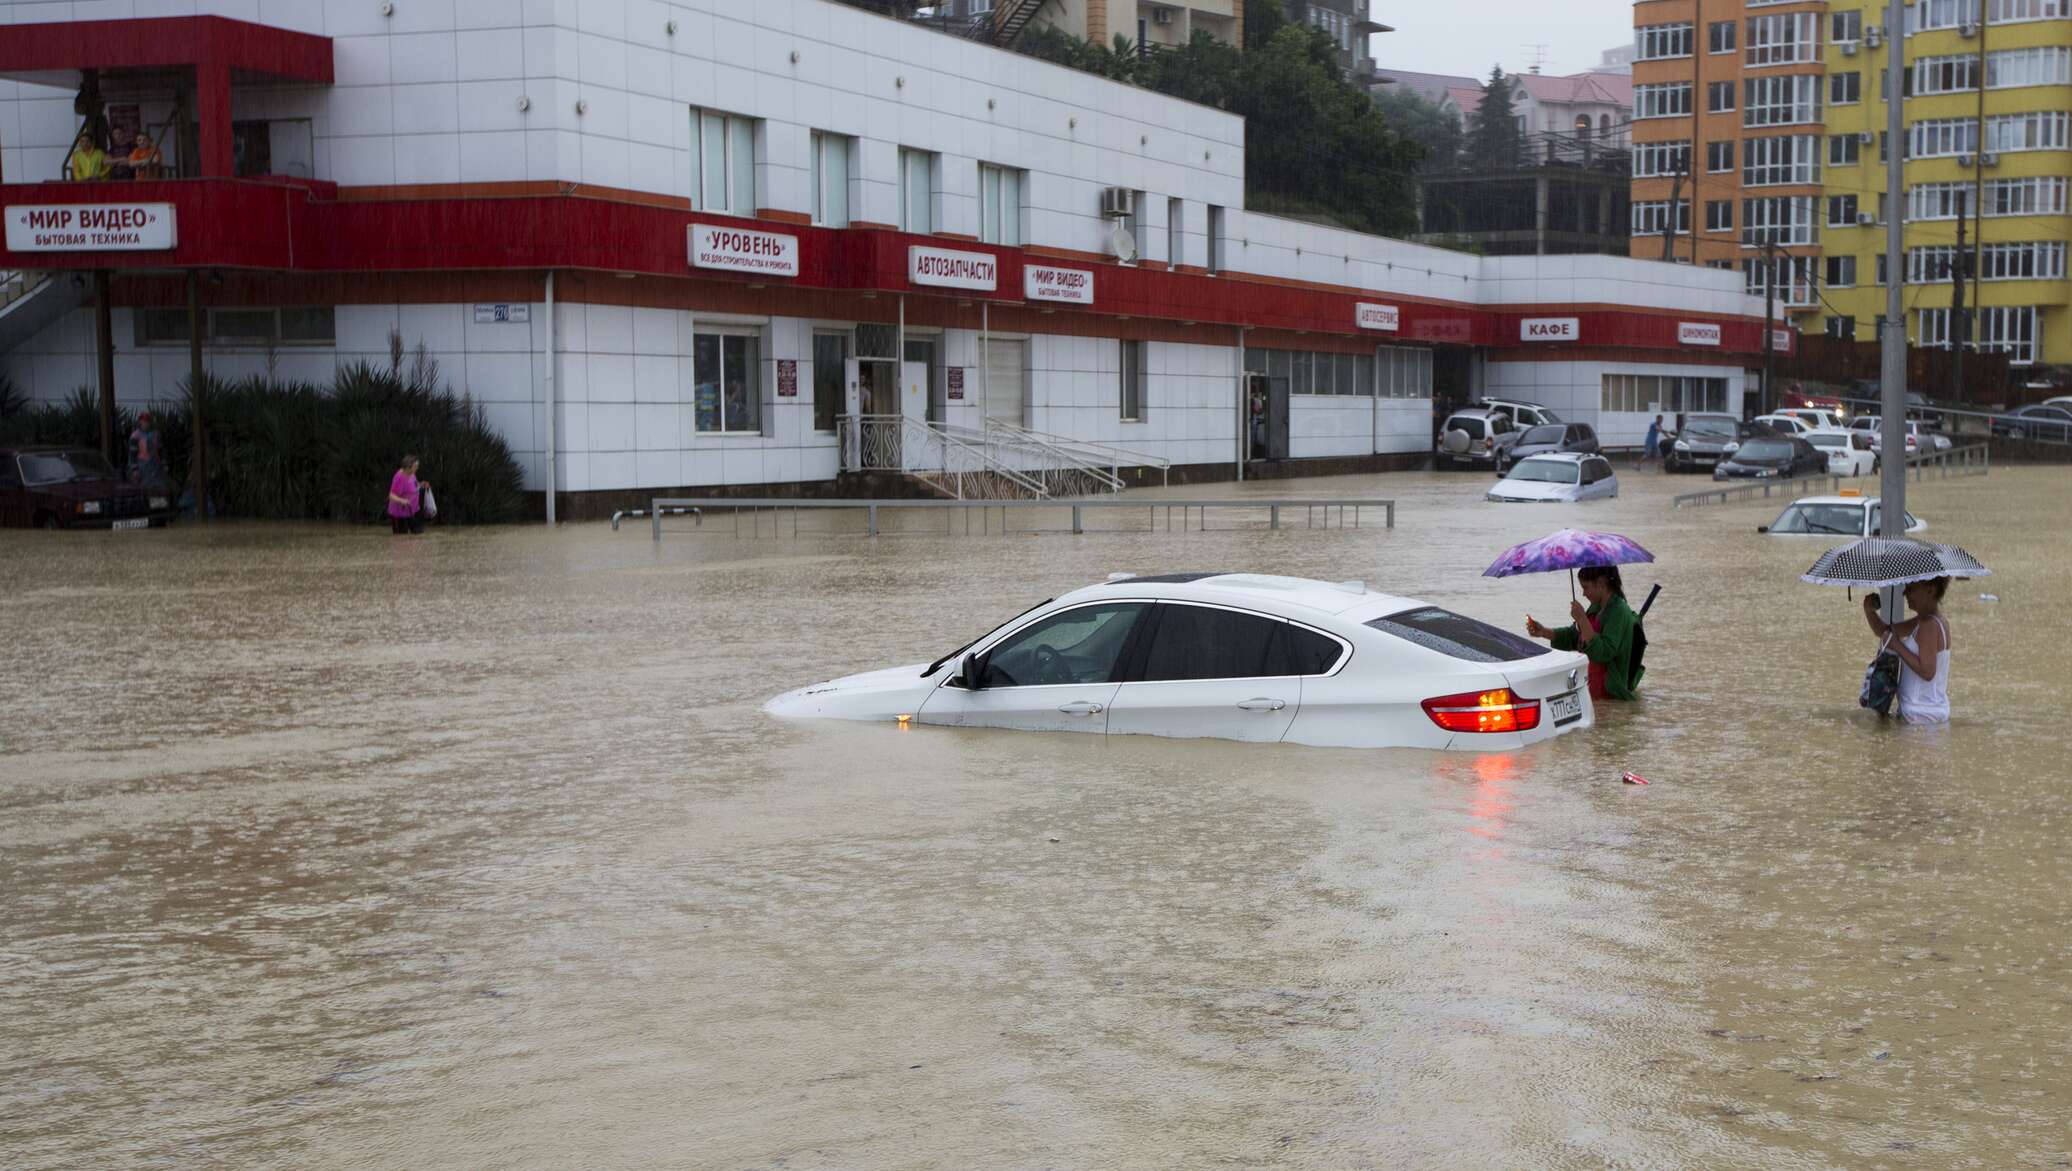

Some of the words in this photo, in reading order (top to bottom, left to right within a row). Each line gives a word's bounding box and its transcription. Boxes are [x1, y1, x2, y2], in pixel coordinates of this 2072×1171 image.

[21, 209, 72, 229] «МИР
[79, 208, 156, 231] ВИДЕО»
[35, 233, 87, 246] БЫТОВАЯ
[90, 232, 140, 245] ТЕХНИКА
[705, 231, 786, 256] «УРОВЕНЬ»
[917, 256, 994, 281] АВТОЗАПЧАСТИ
[1529, 323, 1569, 335] КАФЕ
